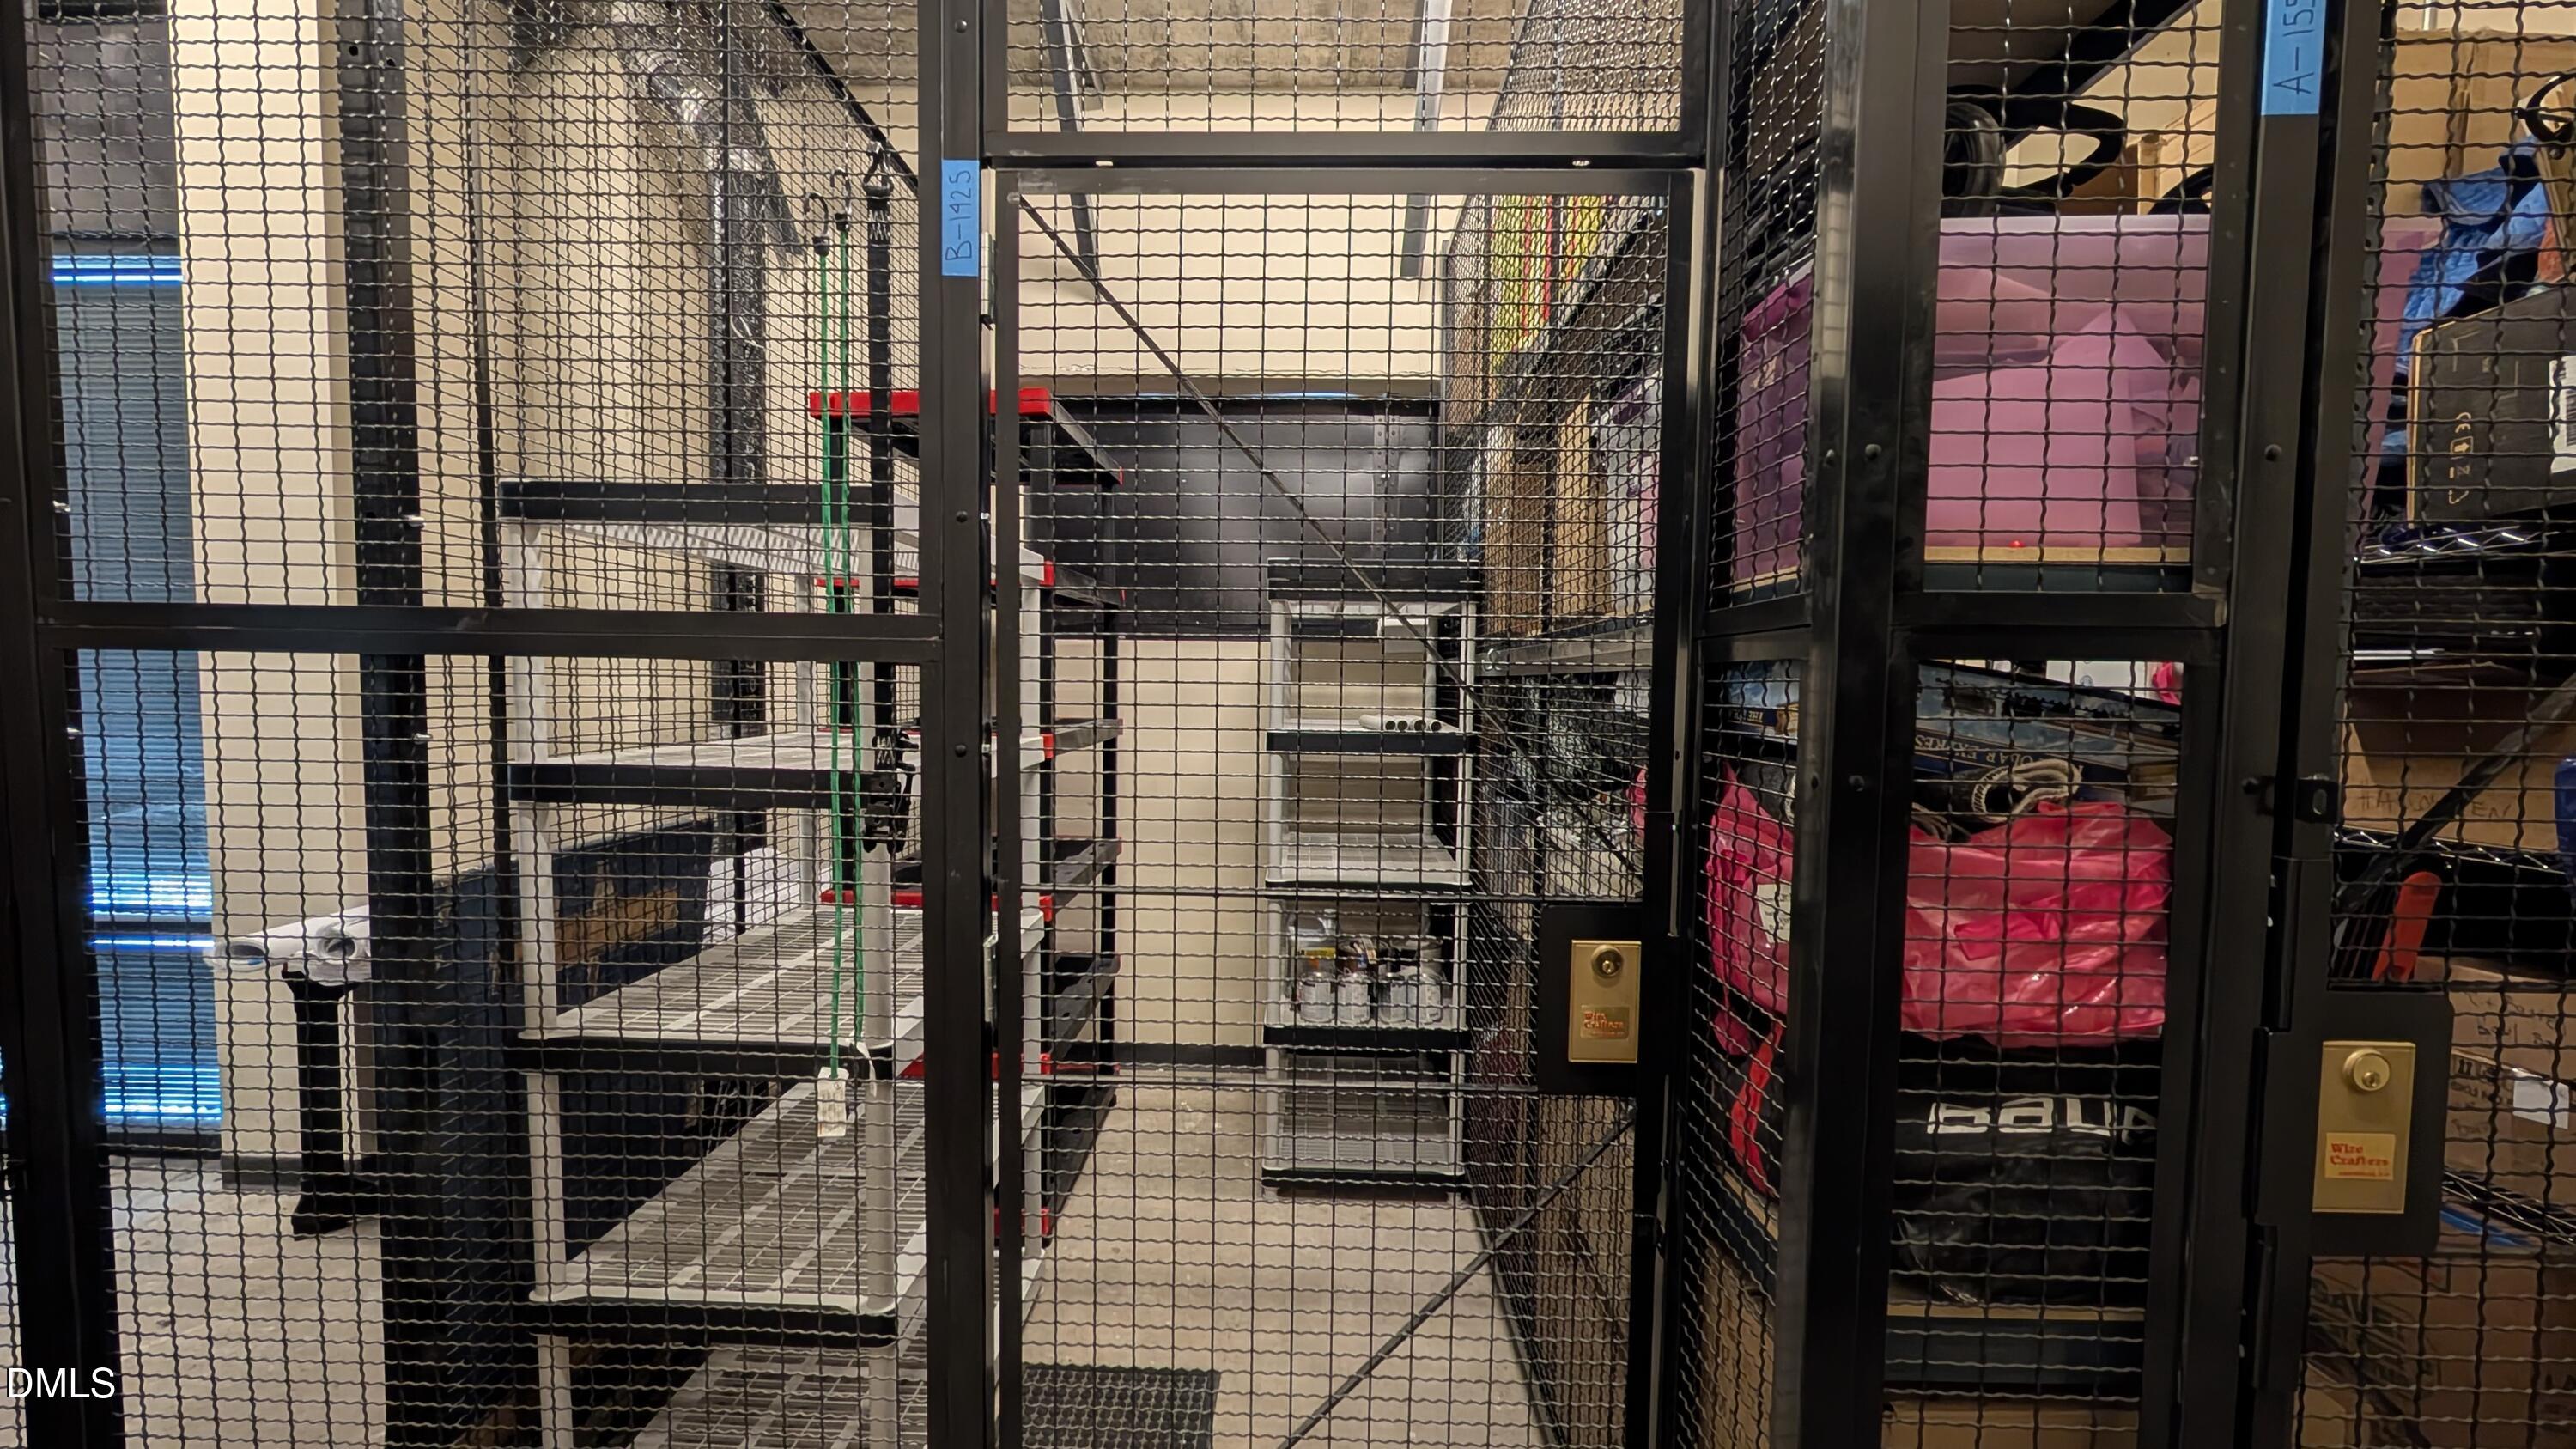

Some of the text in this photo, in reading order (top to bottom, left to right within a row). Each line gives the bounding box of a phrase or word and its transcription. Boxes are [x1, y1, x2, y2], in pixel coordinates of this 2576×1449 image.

[1985, 751, 2038, 765] OLAR
[2330, 1142, 2363, 1154] Wire
[2330, 1154, 2389, 1166] Crafters
